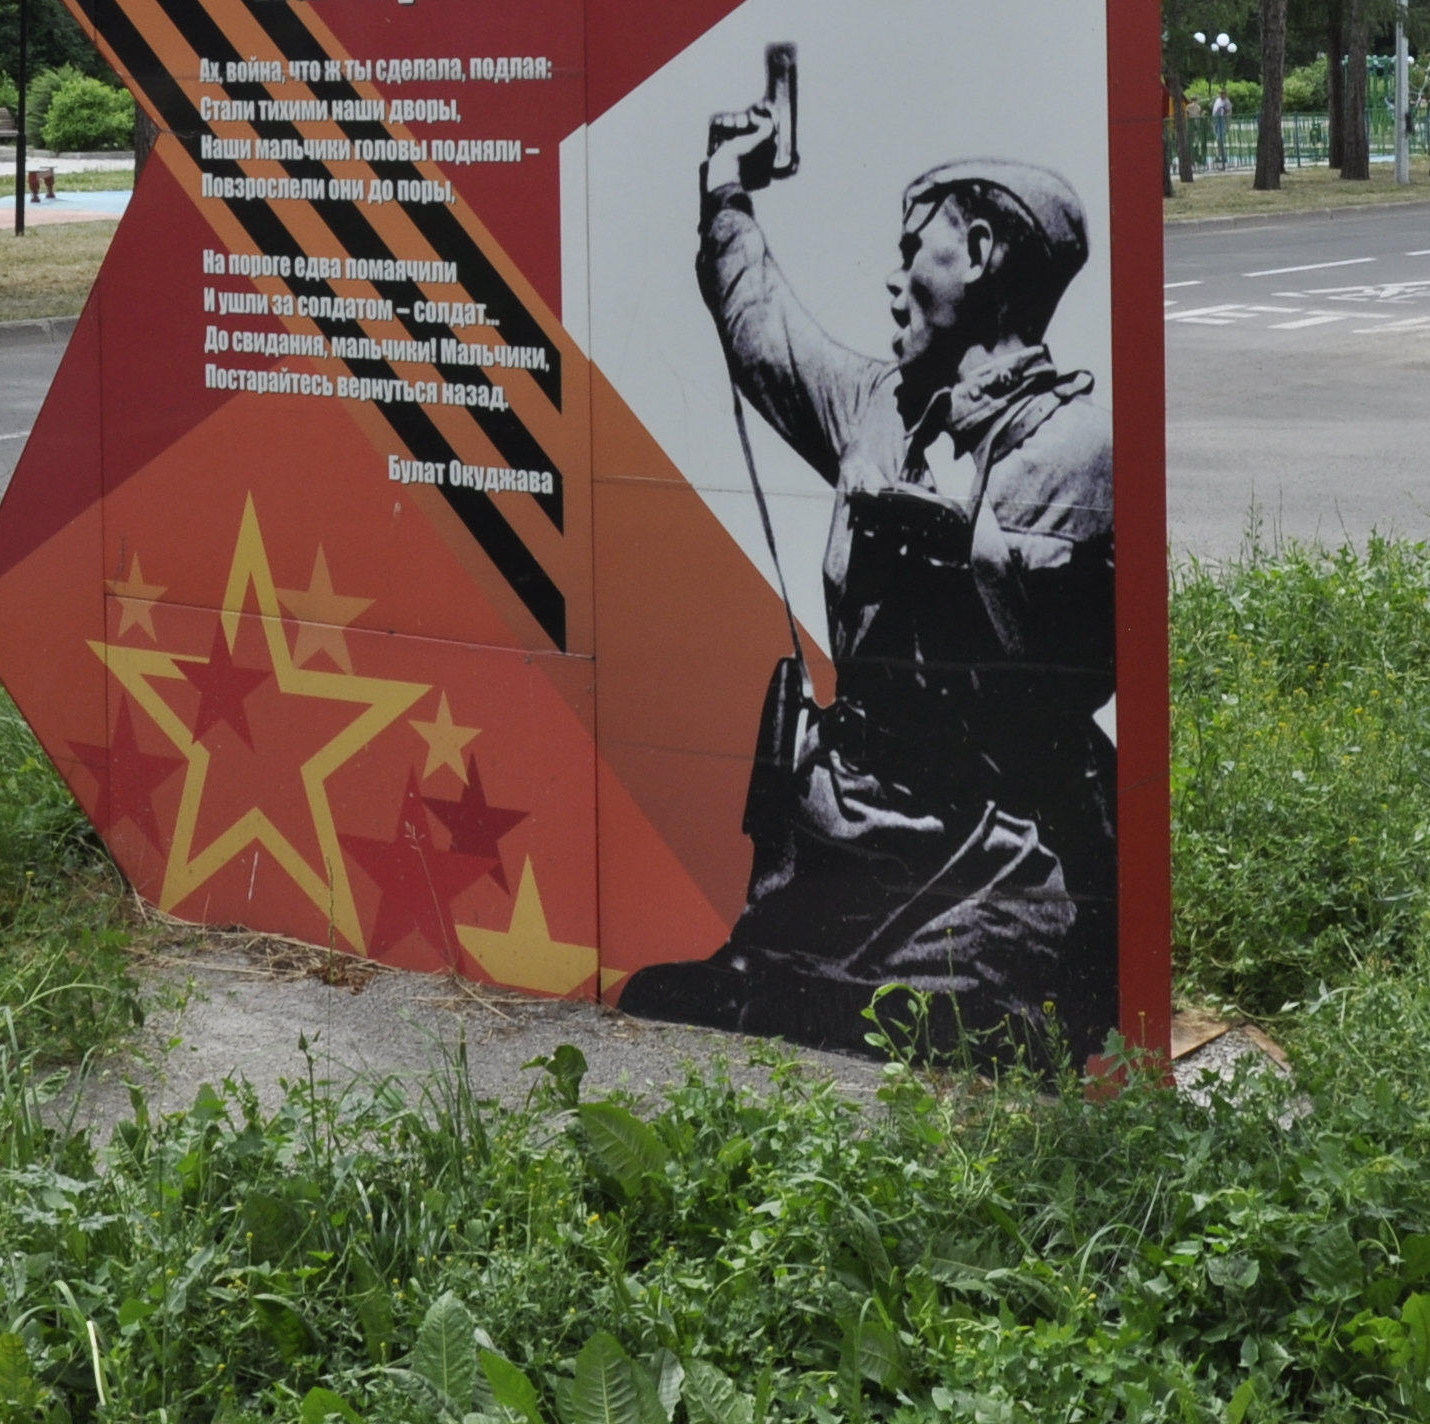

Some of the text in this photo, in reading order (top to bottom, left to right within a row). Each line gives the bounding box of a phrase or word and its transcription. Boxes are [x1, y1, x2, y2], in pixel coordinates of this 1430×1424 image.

[199, 55, 552, 84] Ах, война, что ж ты сделала, подлая:
[200, 96, 461, 124] Стали тихими наши дворы,
[200, 134, 251, 159] Наши
[255, 138, 351, 160] мальчики
[354, 139, 427, 161] головы
[431, 139, 521, 165] подняли
[201, 172, 456, 204] Повзрослели они до поры,
[203, 249, 457, 283] На пороге едва помаячили
[203, 287, 215, 312] И
[218, 291, 269, 315] ушли
[272, 294, 294, 316] за
[297, 295, 393, 322] солдатом
[204, 325, 550, 372] До свидания, мальчики! Мальчики,
[205, 363, 509, 412] Постарайтесь вернуться назад.
[388, 455, 553, 495] Булат Окуджава
